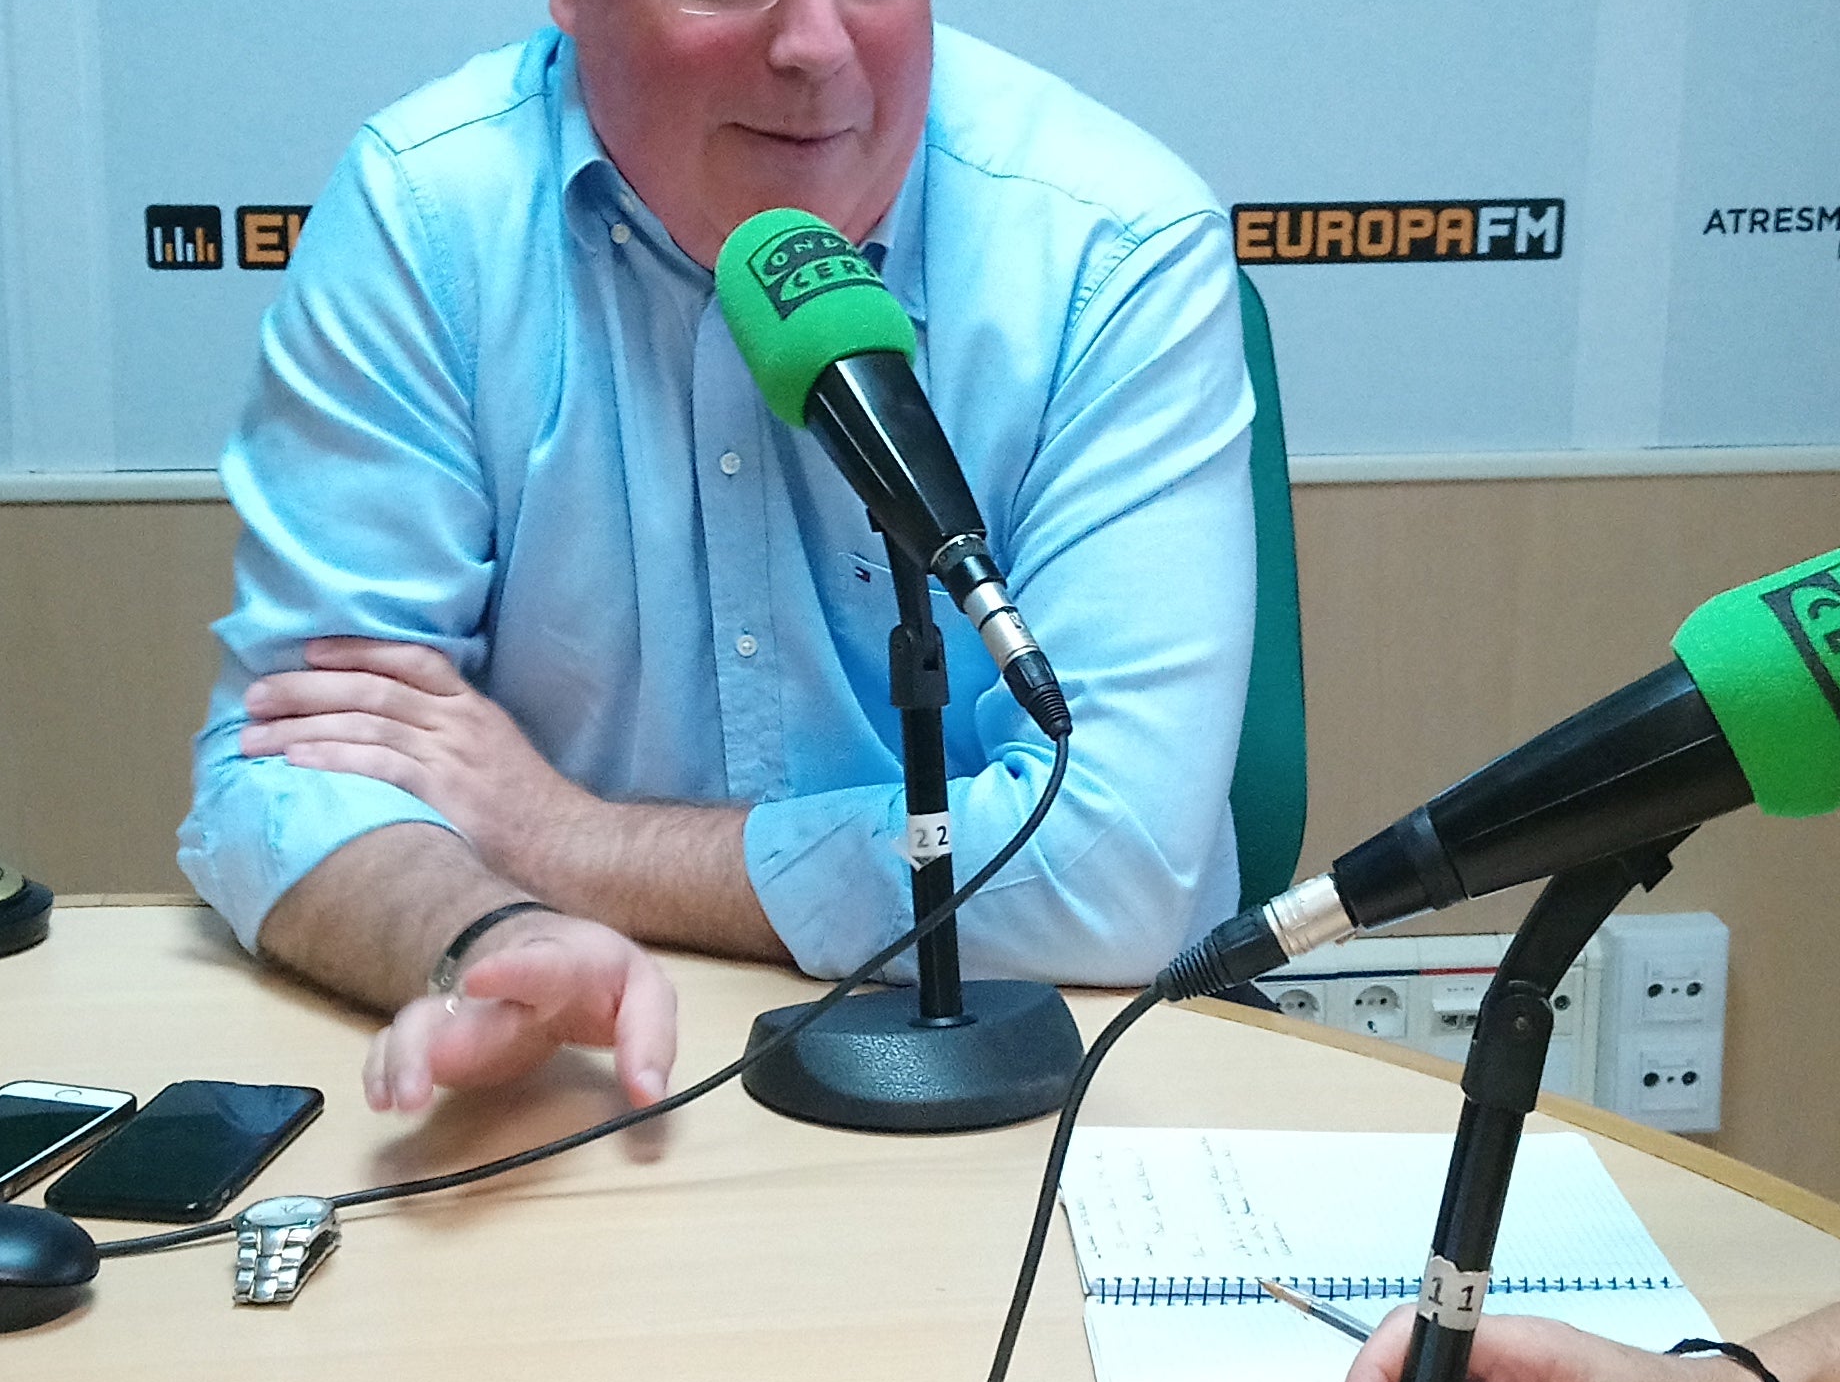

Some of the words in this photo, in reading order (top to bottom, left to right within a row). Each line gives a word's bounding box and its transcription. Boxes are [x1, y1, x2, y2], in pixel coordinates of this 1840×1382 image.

[770, 237, 855, 266] OND
[915, 827, 929, 848] 2
[936, 825, 949, 846] 2
[1428, 1276, 1444, 1307] 1
[1457, 1284, 1475, 1312] 1
